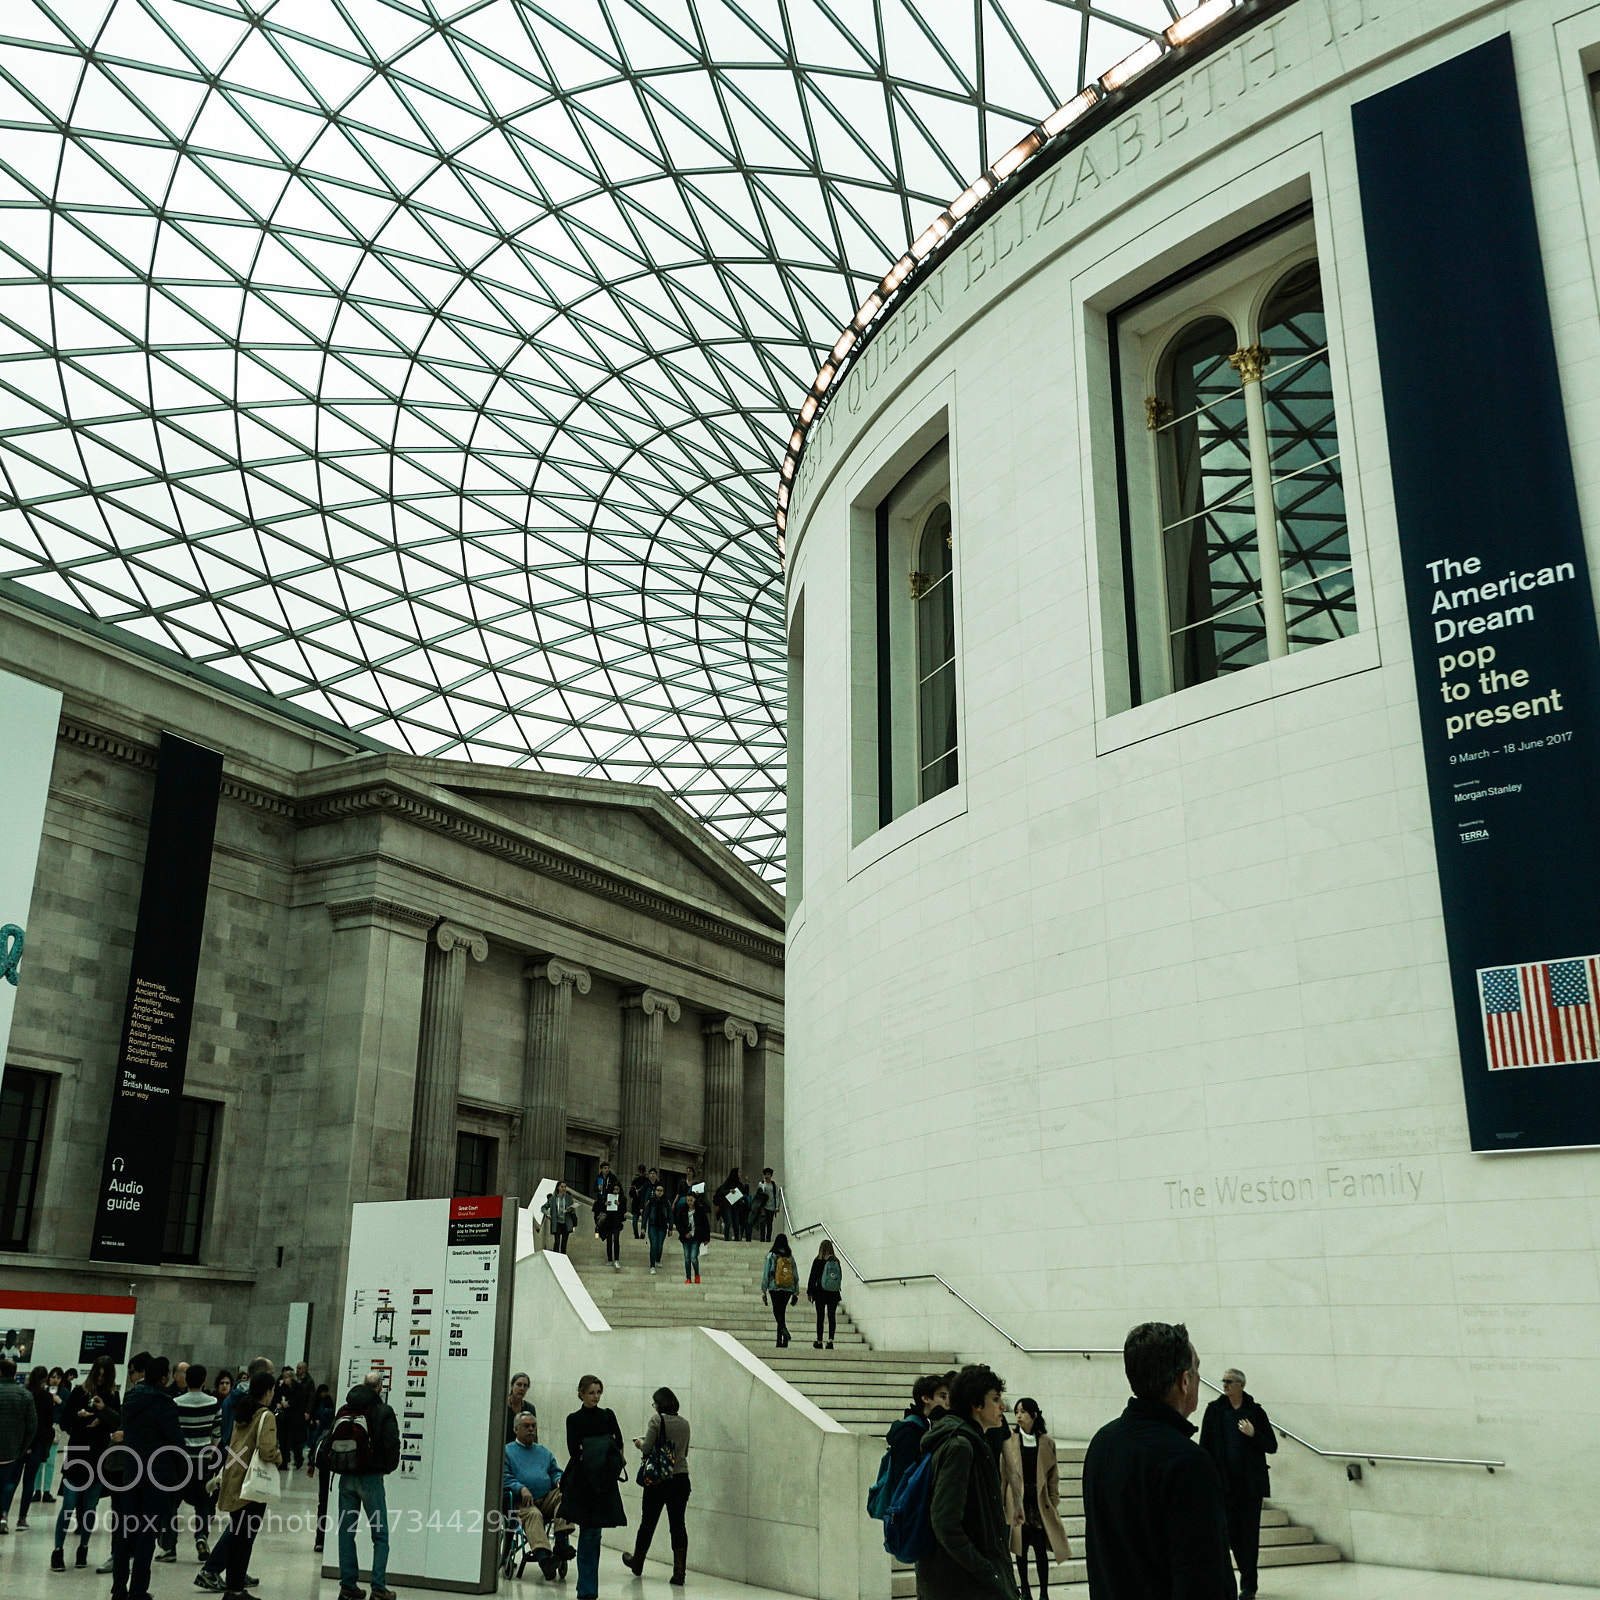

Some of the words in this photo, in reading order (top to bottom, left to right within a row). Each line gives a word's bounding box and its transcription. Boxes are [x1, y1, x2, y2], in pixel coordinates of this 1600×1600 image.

[848, 265, 947, 415] QUEEN
[963, 16, 1291, 292] ELIZABETH
[1426, 556, 1482, 584] The
[1431, 562, 1575, 615] American
[1434, 604, 1535, 643] Dream
[1438, 645, 1496, 678] pop
[1440, 681, 1471, 704] to
[1478, 668, 1530, 695] the
[1445, 688, 1564, 739] present
[1449, 755, 1457, 765] 9
[1459, 749, 1490, 762] March
[1503, 743, 1515, 753] 18
[1518, 739, 1544, 751] June
[1546, 731, 1573, 746] 2017
[1459, 829, 1490, 841] TERRA
[135, 987, 158, 998] Ancient
[159, 992, 181, 1004] Greece.
[131, 1011, 153, 1023] African
[129, 1028, 147, 1039] Asian
[128, 1037, 150, 1048] Roman
[126, 1054, 149, 1065] Ancient
[124, 1070, 136, 1080] The
[121, 1089, 136, 1097] your
[136, 1093, 149, 1101] way
[122, 1079, 143, 1090] British
[144, 1083, 170, 1095] Museum
[108, 1178, 144, 1195] Audio
[1163, 1179, 1206, 1210] The
[1215, 1175, 1314, 1206] Weston
[1326, 1162, 1424, 1202] Family
[106, 1196, 141, 1212] guide
